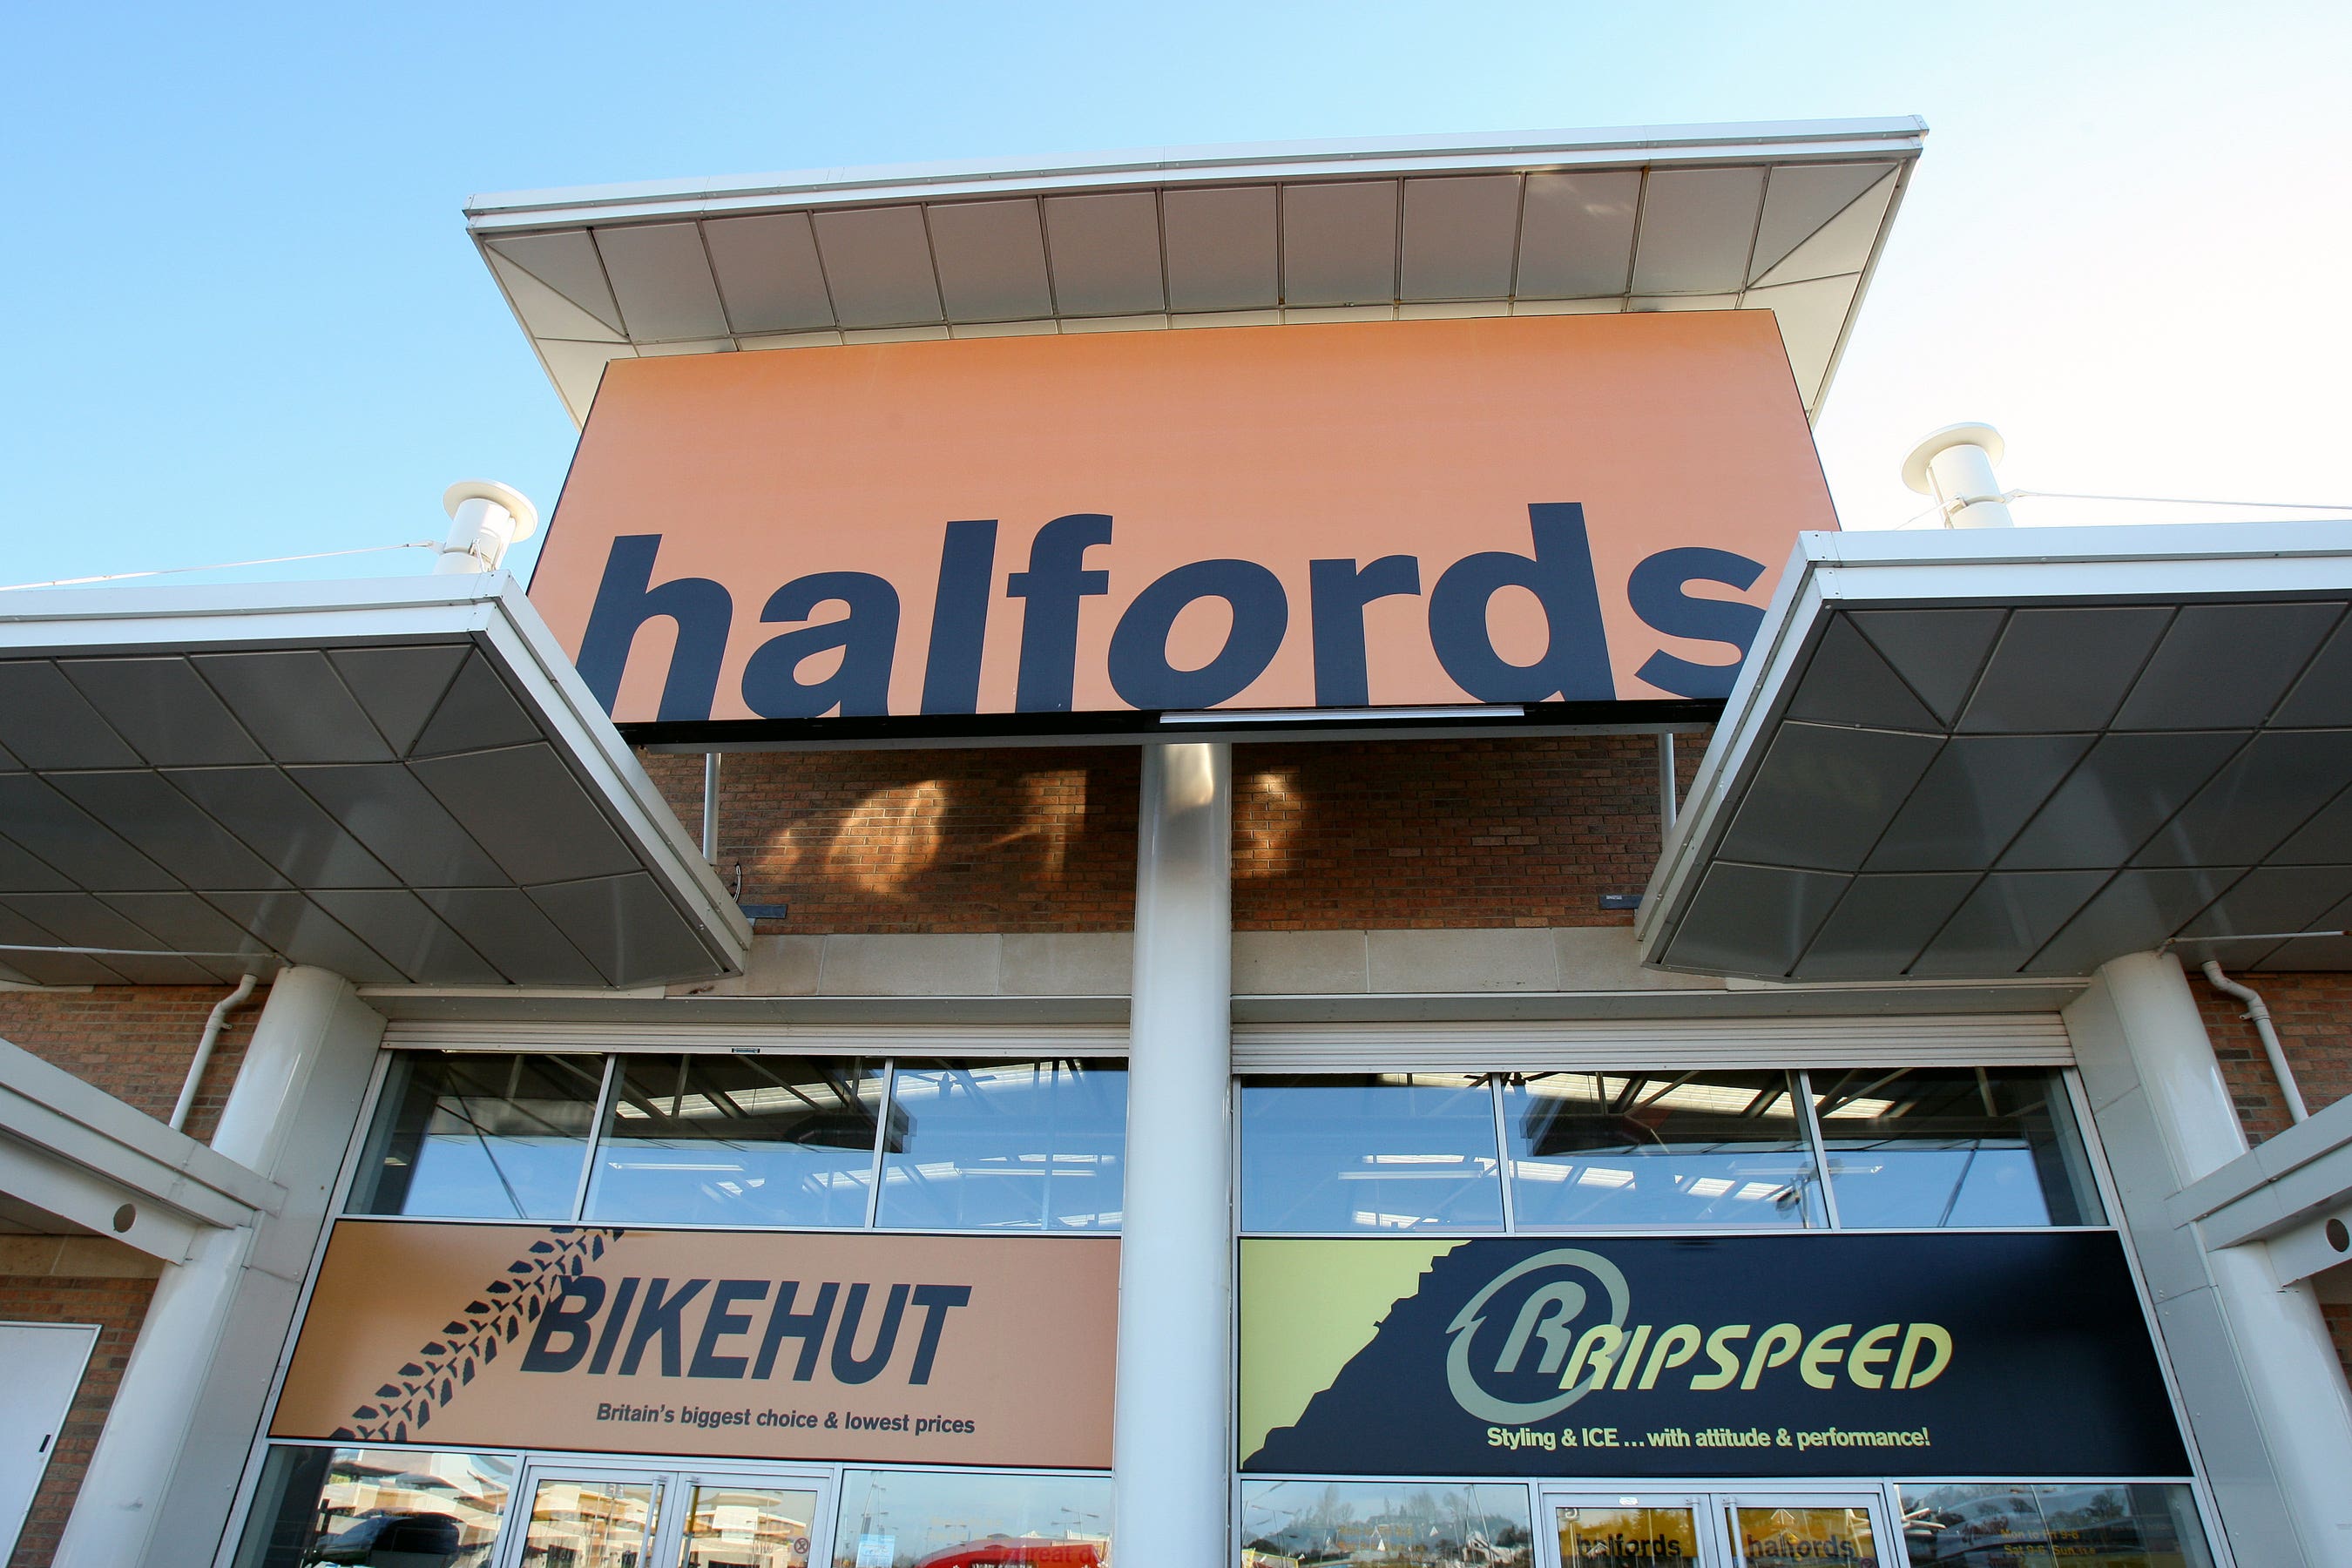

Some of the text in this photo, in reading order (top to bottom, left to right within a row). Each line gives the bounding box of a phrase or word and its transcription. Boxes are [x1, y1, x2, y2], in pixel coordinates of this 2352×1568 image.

[578, 502, 1768, 723] halfords
[520, 1274, 973, 1385] BIKEHUT
[1558, 1322, 1954, 1390] RIPSPEED
[596, 1402, 976, 1436] Britain's biggest choice & lowest prices
[1486, 1427, 1557, 1451] Styling
[1561, 1427, 1578, 1447] &
[1581, 1427, 1620, 1447] ICE
[1694, 1427, 1771, 1447] attitude
[1775, 1427, 1793, 1447] &
[1796, 1426, 1931, 1451] performance!
[1575, 1532, 1681, 1557] halfords
